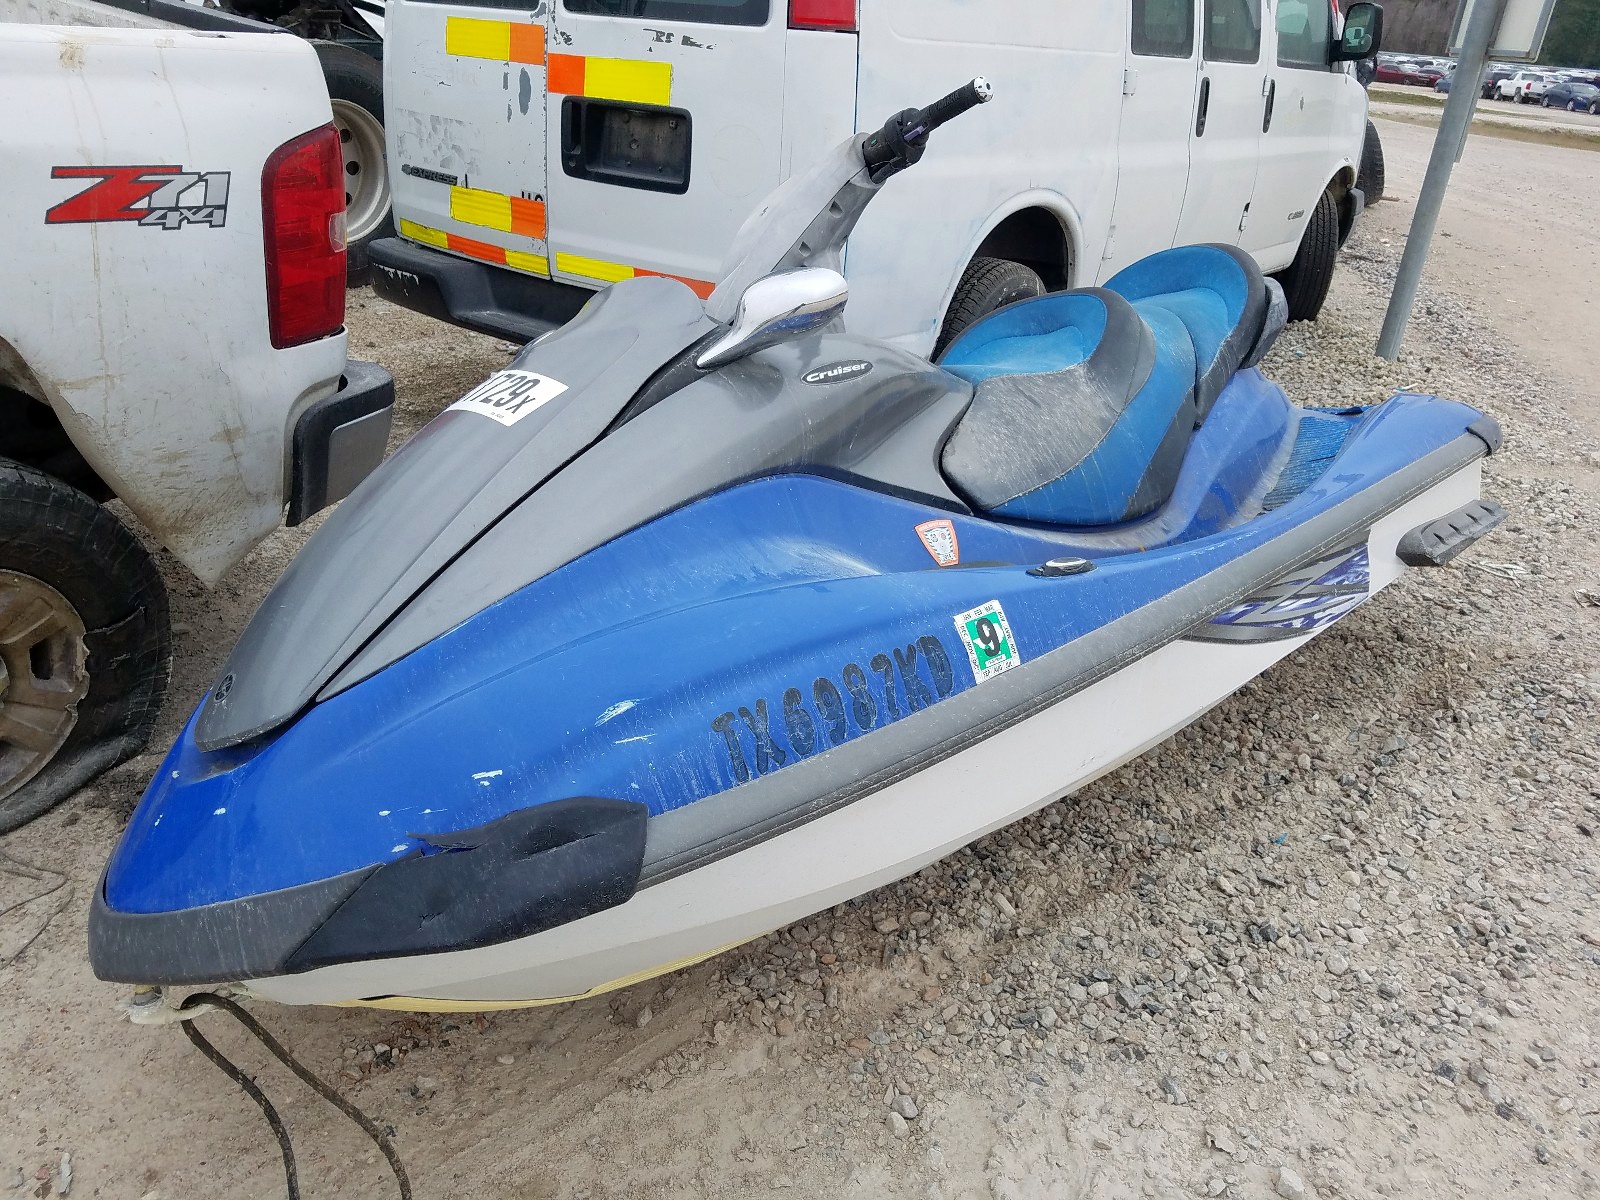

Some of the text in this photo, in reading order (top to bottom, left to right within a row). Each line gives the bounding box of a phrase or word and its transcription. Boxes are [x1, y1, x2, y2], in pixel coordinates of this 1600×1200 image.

[410, 165, 458, 186] EXPRESS
[45, 165, 231, 224] Z71
[806, 362, 869, 382] Cruiser
[976, 617, 1001, 657] 9
